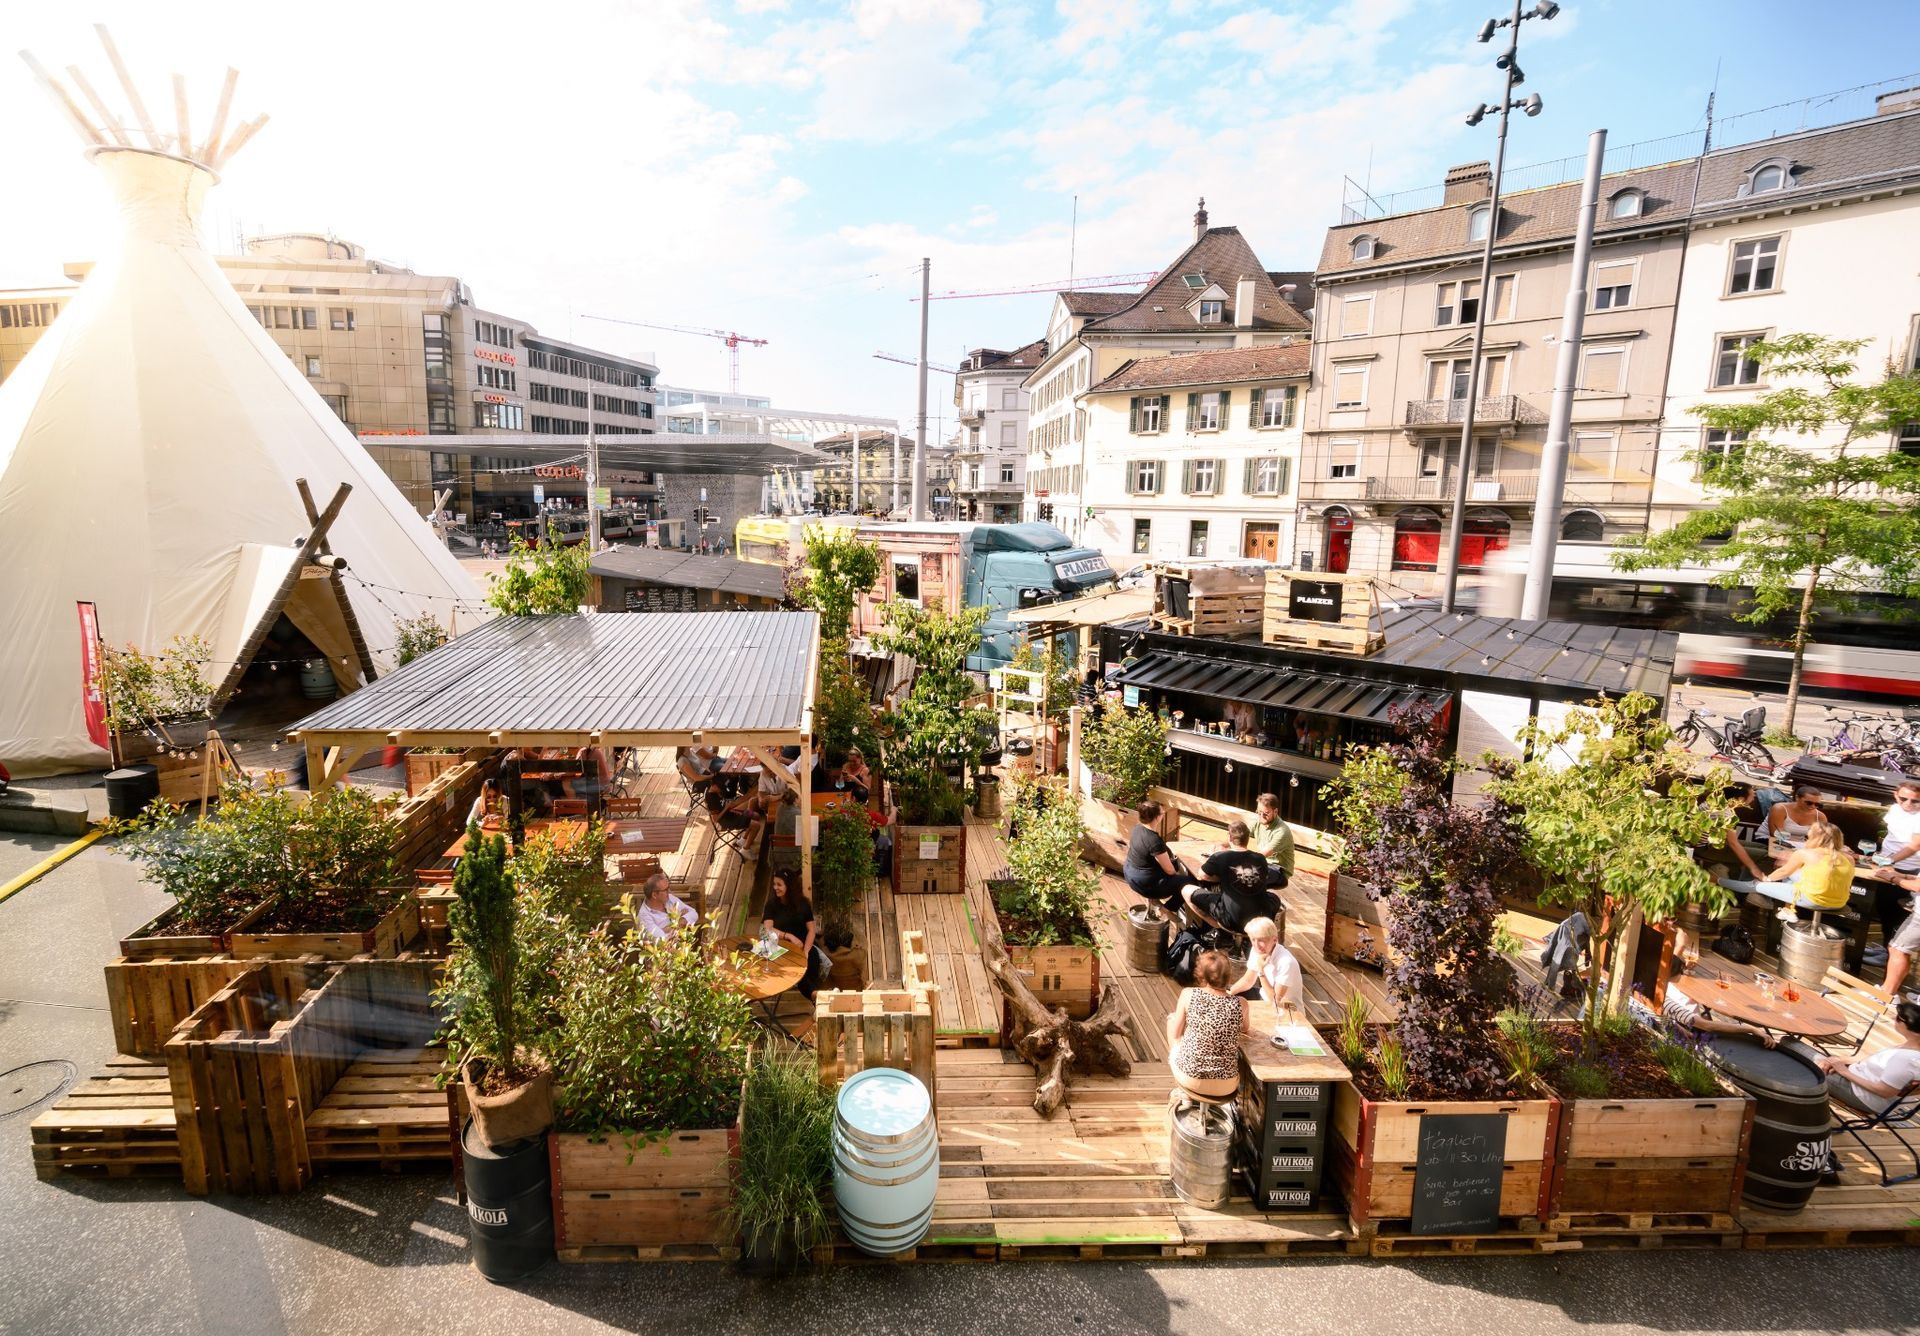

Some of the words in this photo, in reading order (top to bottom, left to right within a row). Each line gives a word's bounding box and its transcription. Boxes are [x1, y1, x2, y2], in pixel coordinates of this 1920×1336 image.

[500, 352, 518, 367] city
[535, 465, 564, 479] coop
[564, 464, 583, 480] city
[1061, 556, 1108, 577] PLANZER
[1297, 596, 1334, 606] PLANZER
[1277, 1087, 1296, 1096] VIVI
[1297, 1087, 1319, 1096] KOLA
[1275, 1122, 1294, 1131] VIVI
[1295, 1122, 1317, 1131] KOLA
[1272, 1157, 1292, 1166] VIVI
[1292, 1157, 1314, 1166] KOLA
[1481, 1151, 1503, 1164] Uhr
[1780, 1155, 1800, 1171] &
[1269, 1191, 1289, 1201] VIVI
[1289, 1191, 1311, 1201] KOLA
[477, 1209, 508, 1223] KOLA
